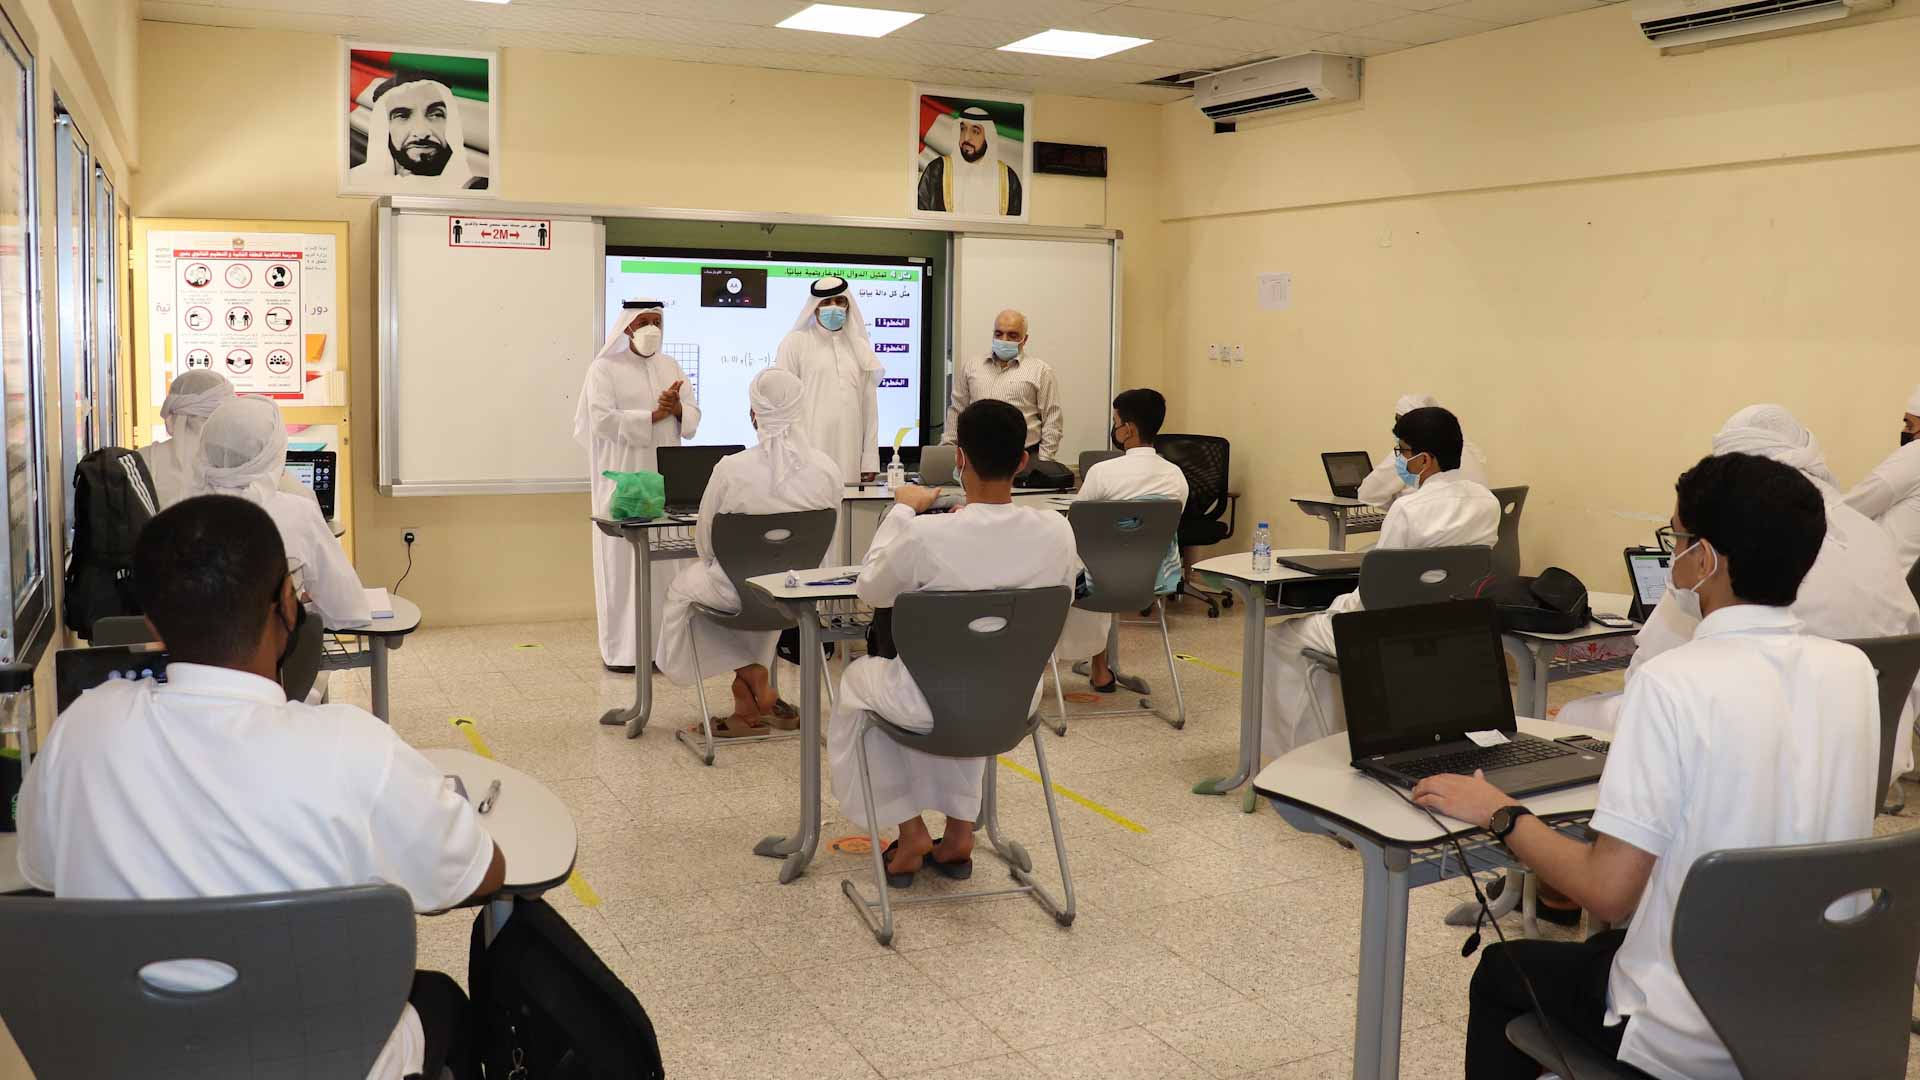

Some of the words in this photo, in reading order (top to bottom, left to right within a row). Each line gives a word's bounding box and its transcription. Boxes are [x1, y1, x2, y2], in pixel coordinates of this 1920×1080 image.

[493, 229, 508, 239] 2M
[883, 318, 906, 328] الخطوة
[883, 344, 906, 353] الخطوة
